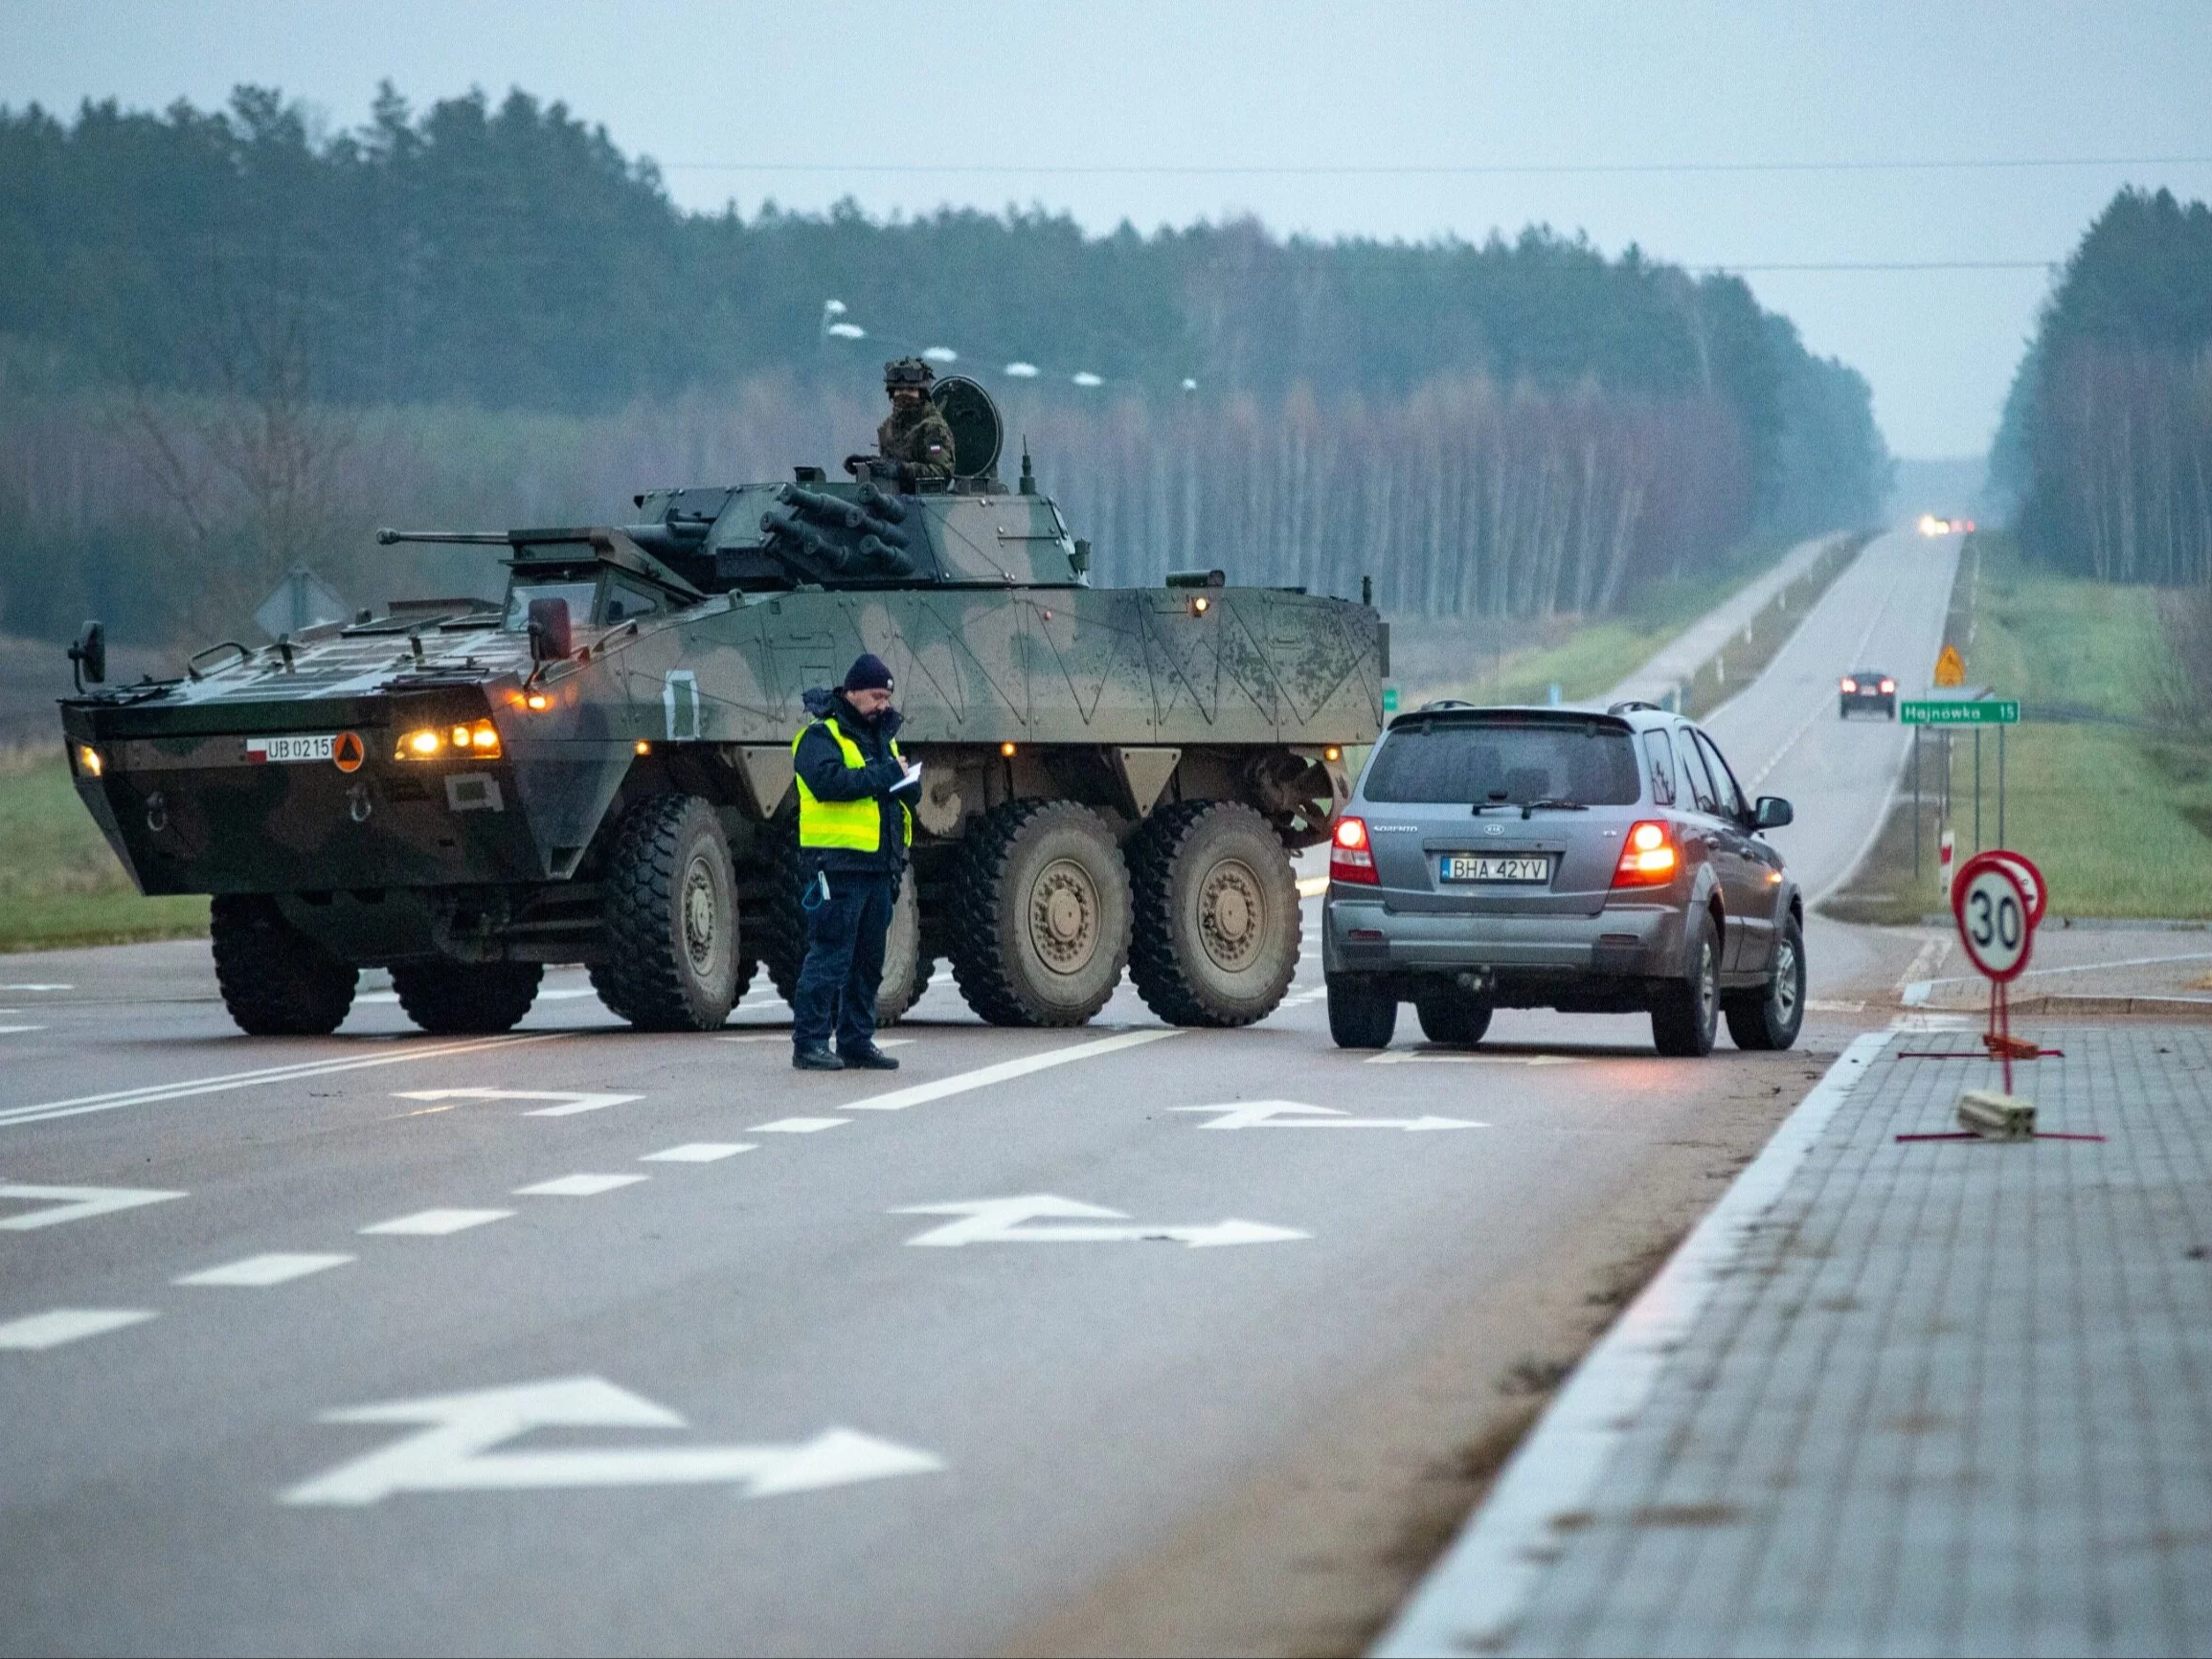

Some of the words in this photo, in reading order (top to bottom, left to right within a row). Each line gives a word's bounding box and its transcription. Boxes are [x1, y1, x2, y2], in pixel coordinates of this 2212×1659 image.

[1999, 705, 2014, 719] 15
[269, 741, 289, 757] UB
[293, 738, 334, 757] 0215
[1454, 860, 1489, 878] BHA
[1496, 861, 1542, 879] 42YV
[1972, 889, 2019, 950] 30
